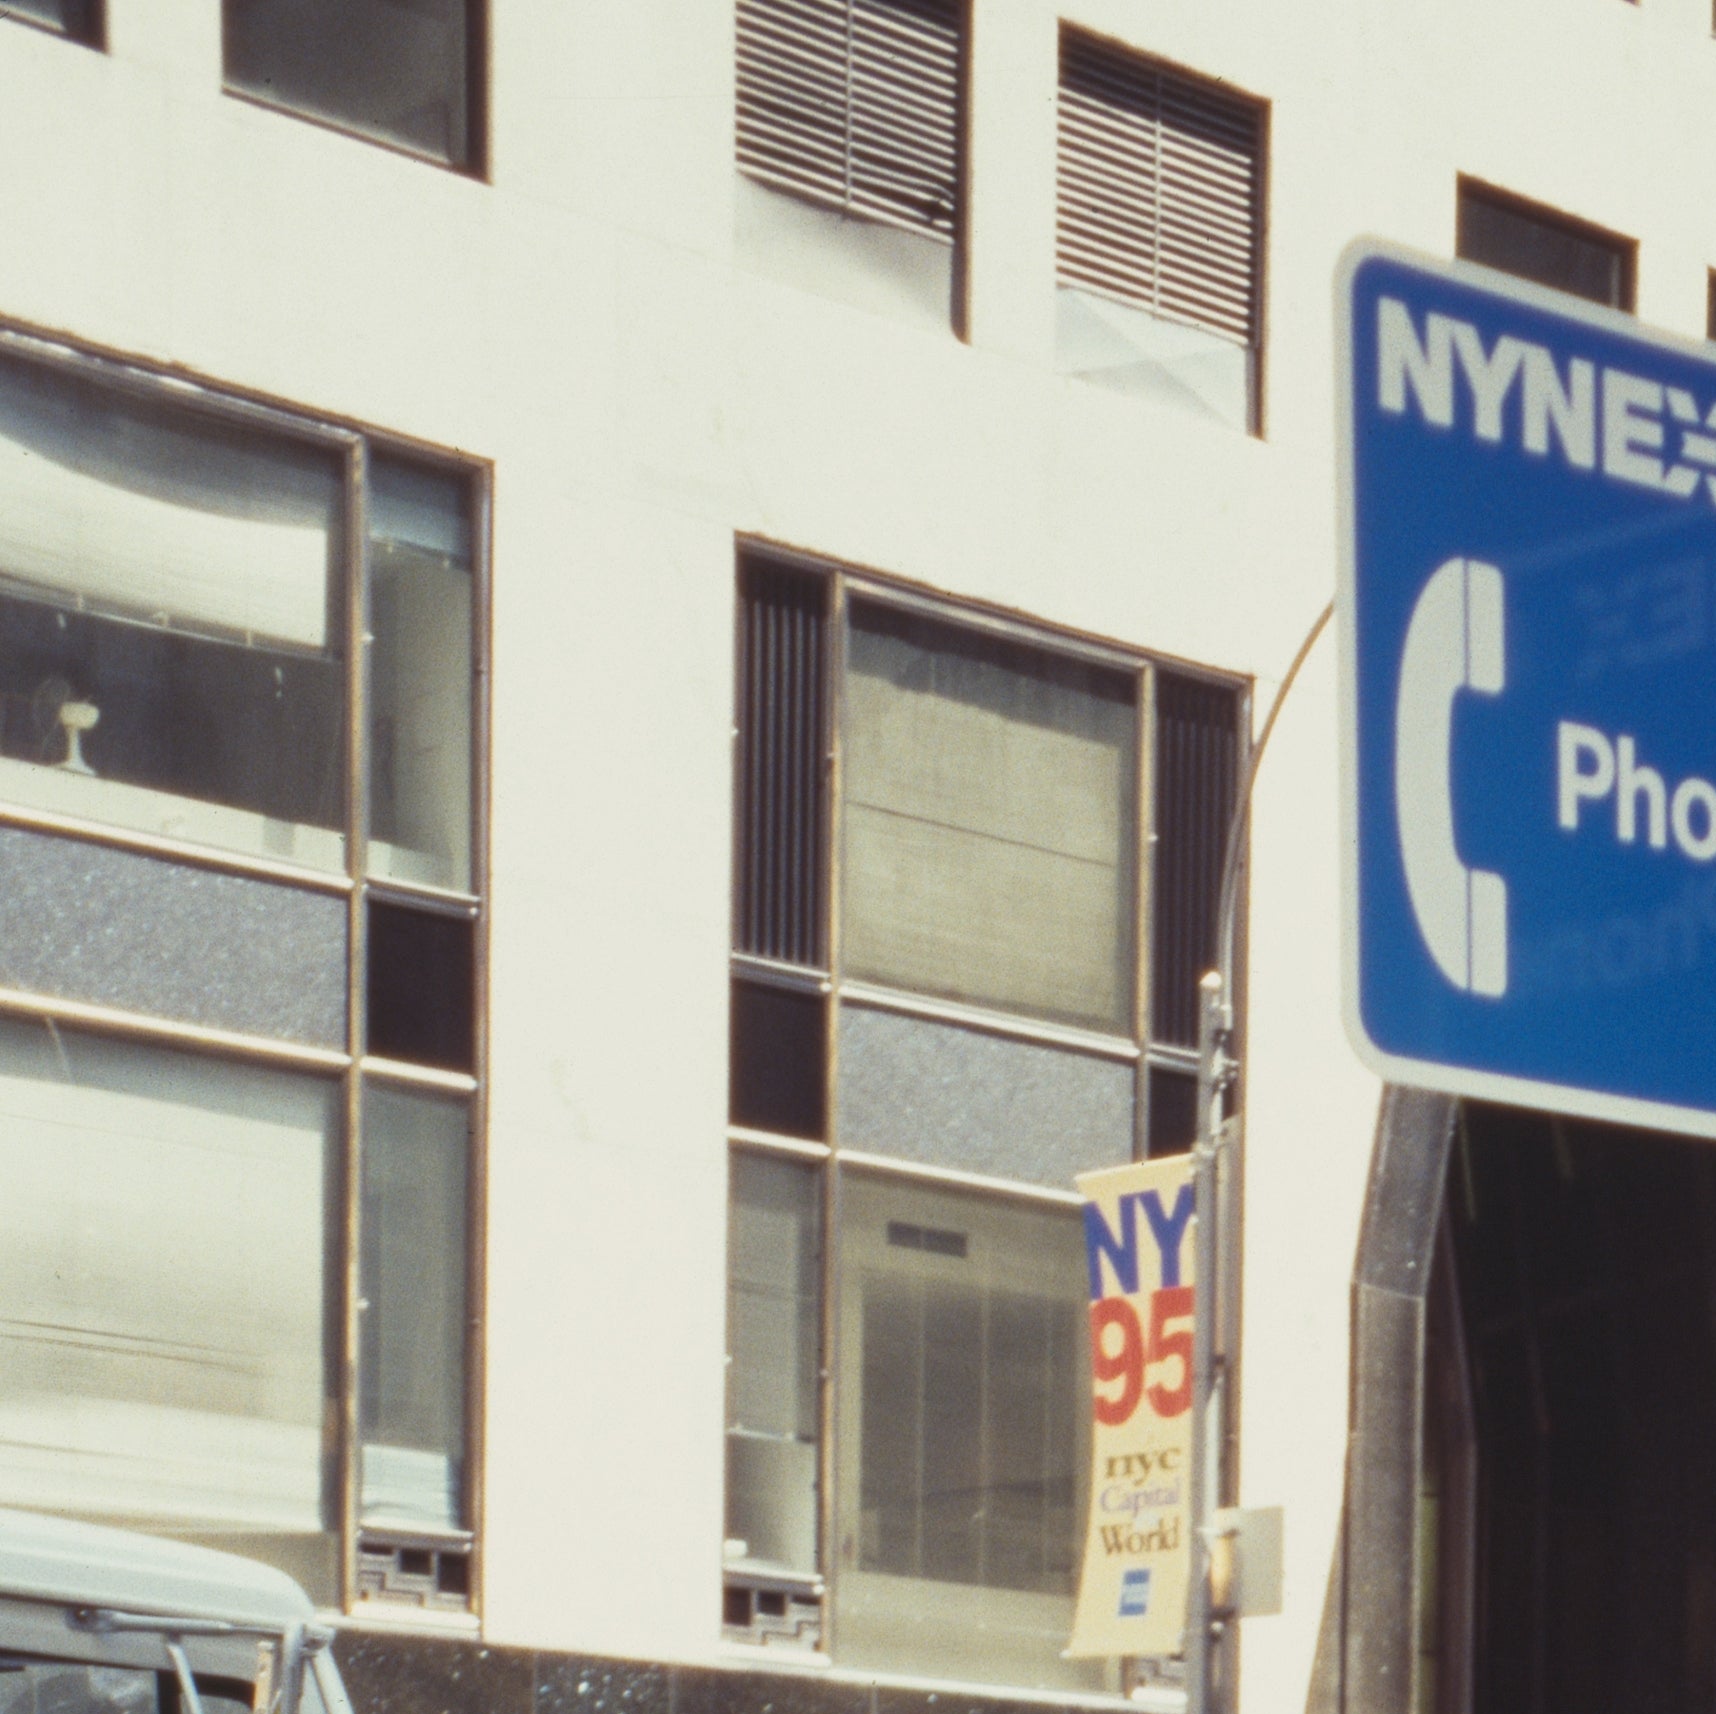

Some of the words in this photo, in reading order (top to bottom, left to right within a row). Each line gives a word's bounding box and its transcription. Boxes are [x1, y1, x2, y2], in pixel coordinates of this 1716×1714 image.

[1082, 1183, 1196, 1299] NY
[1089, 1286, 1195, 1427] 95
[1106, 1447, 1181, 1487] nyc
[1100, 1516, 1181, 1556] World
